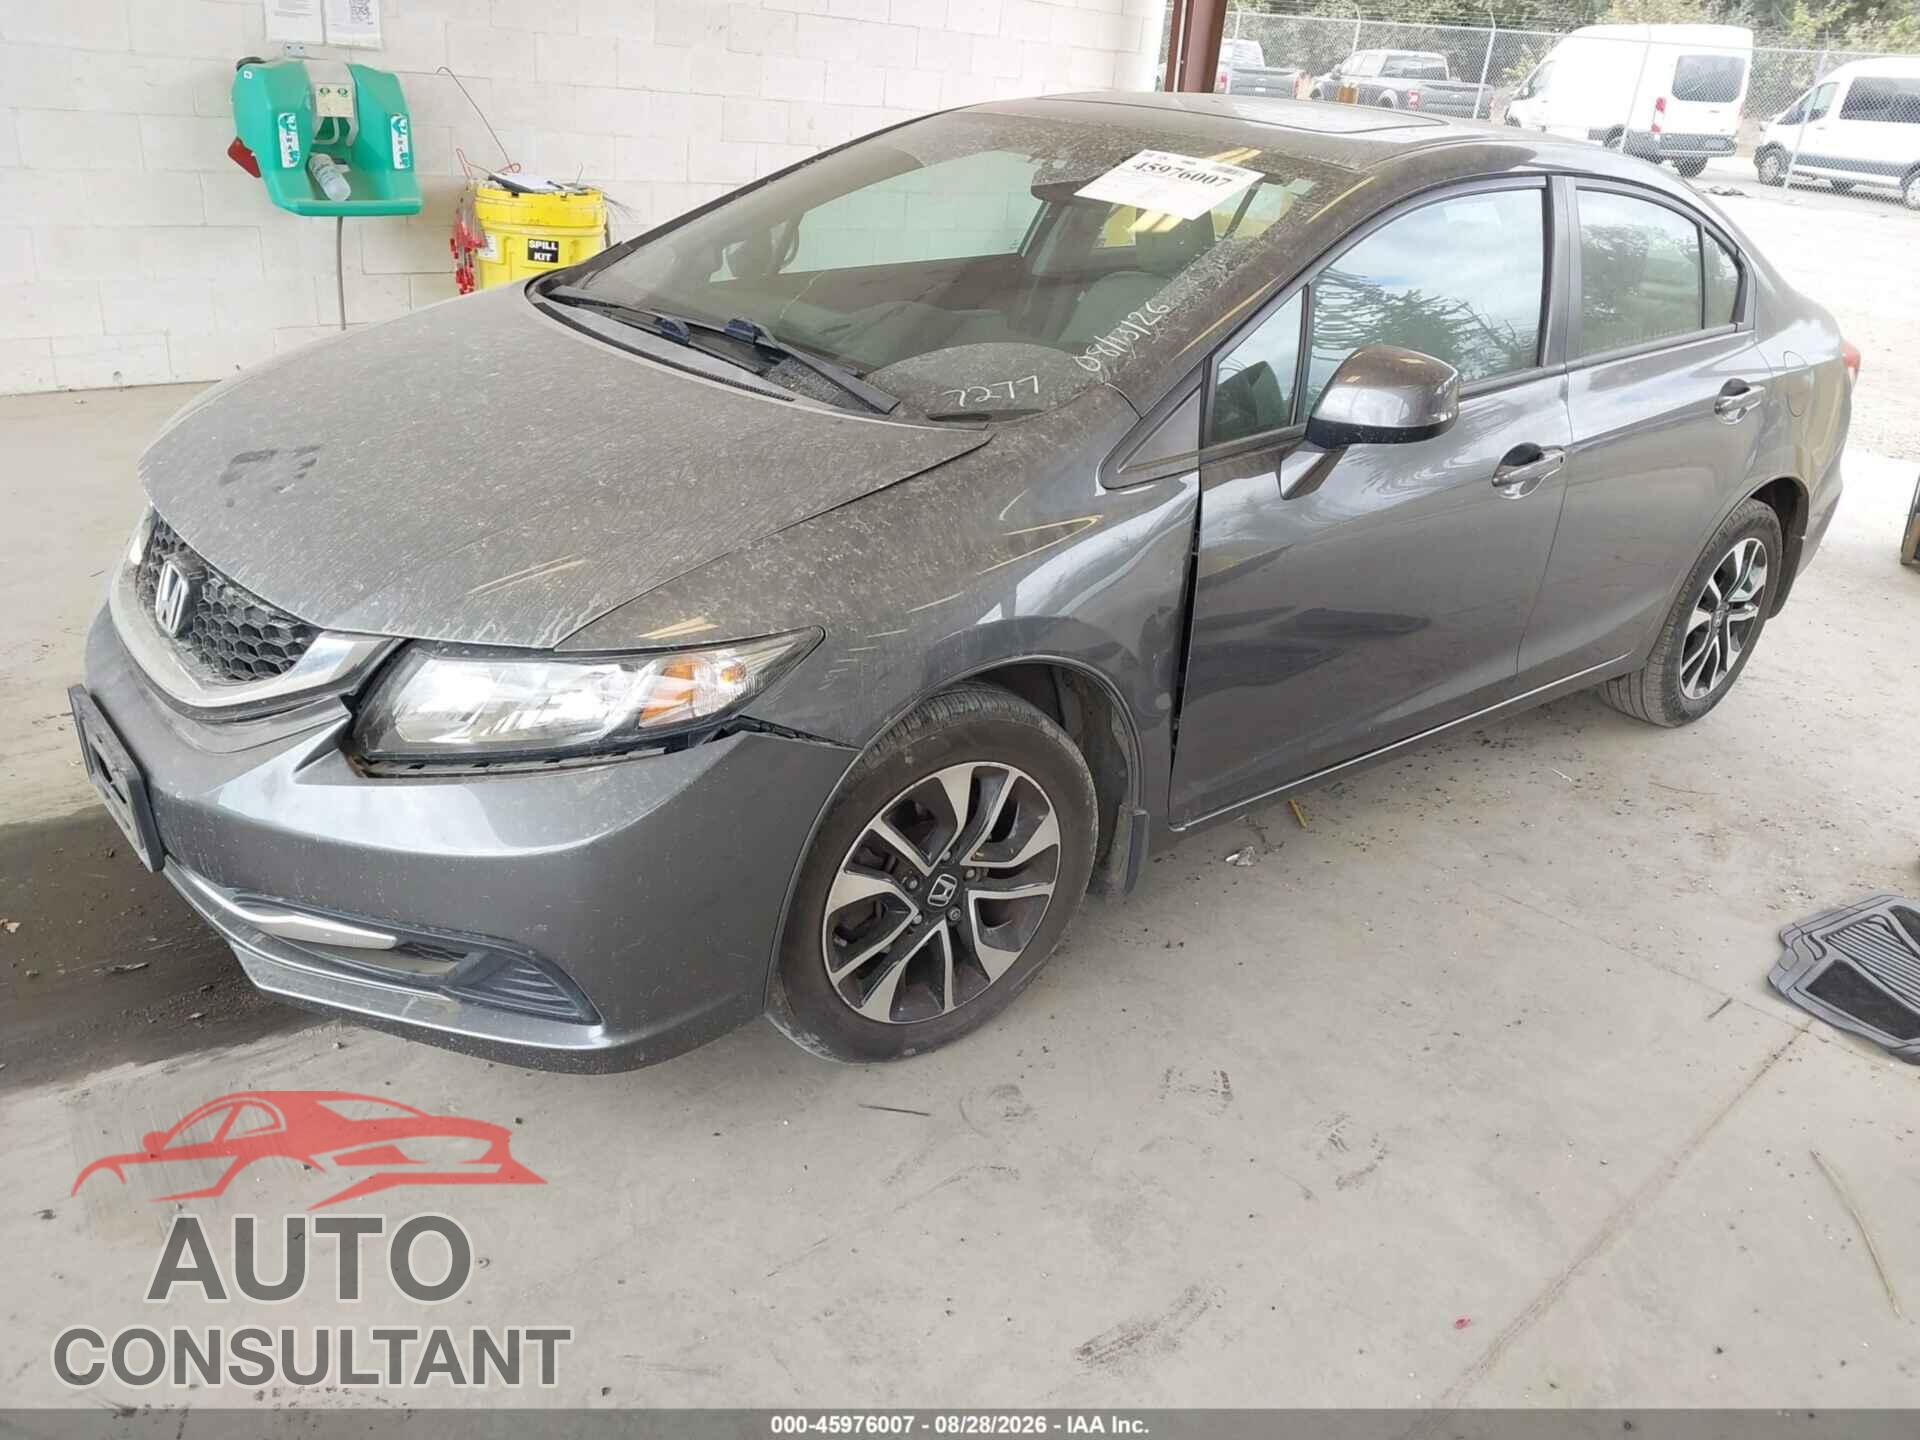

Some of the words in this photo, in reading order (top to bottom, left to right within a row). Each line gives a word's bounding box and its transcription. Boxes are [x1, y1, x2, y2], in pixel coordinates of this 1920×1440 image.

[1134, 161, 1233, 187] 45976007
[528, 239, 558, 251] SPILL
[533, 251, 553, 262] KIT
[941, 375, 1039, 408] 7277
